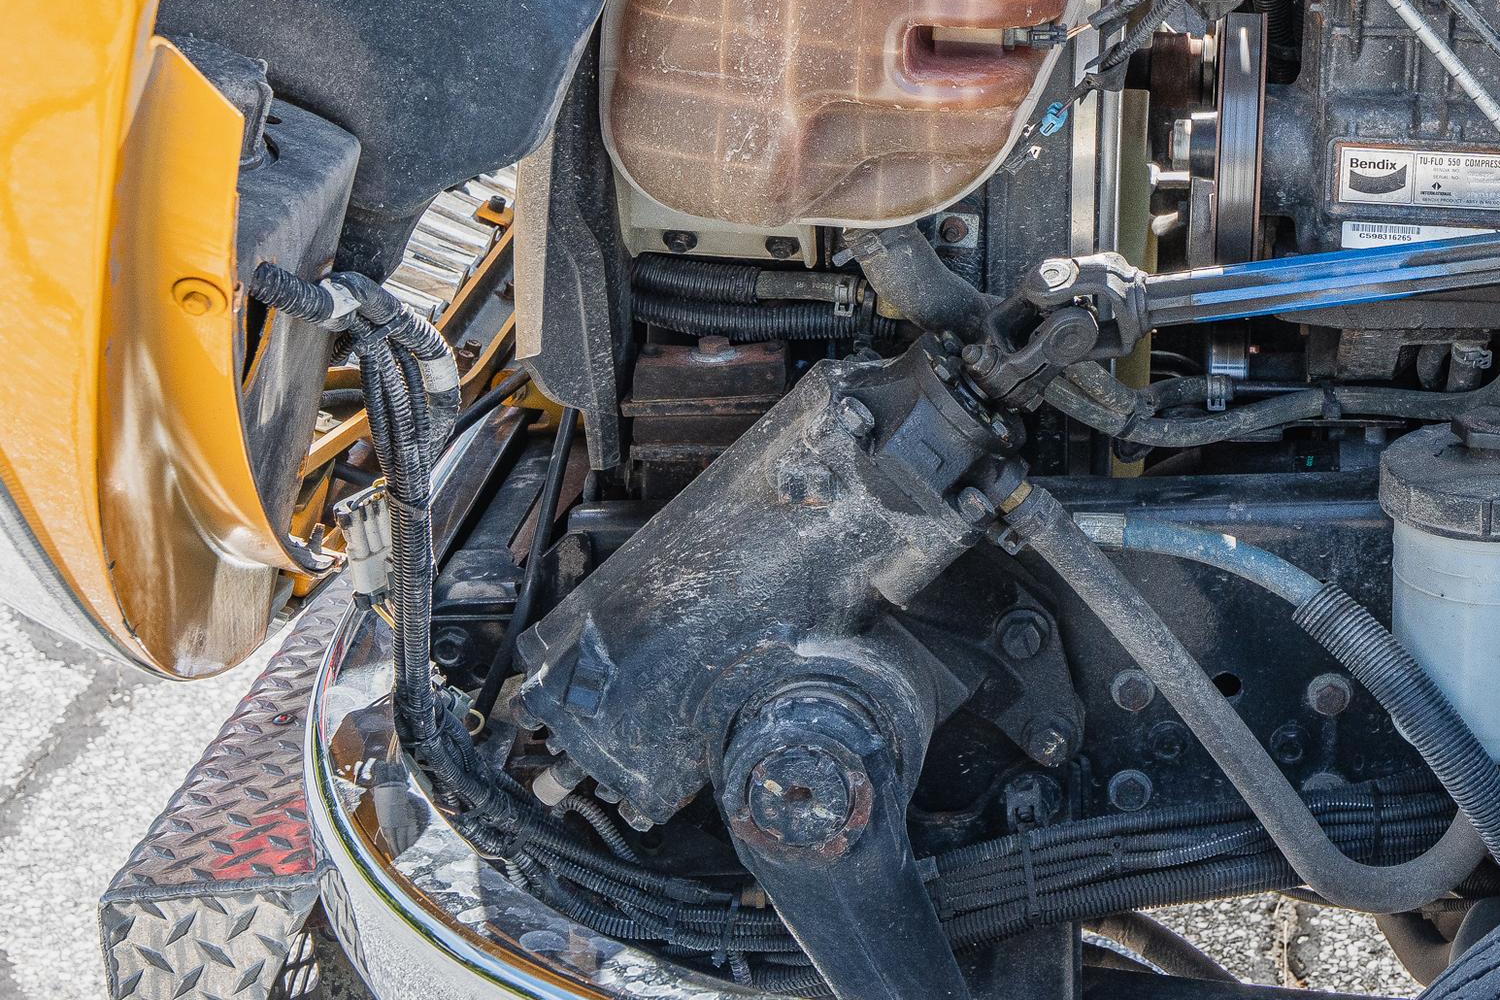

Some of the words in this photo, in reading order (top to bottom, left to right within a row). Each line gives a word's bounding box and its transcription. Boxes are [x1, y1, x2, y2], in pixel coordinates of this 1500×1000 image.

[1349, 157, 1397, 170] Bendix
[1420, 157, 1443, 166] TU-FLO
[1359, 232, 1412, 242] C598316265
